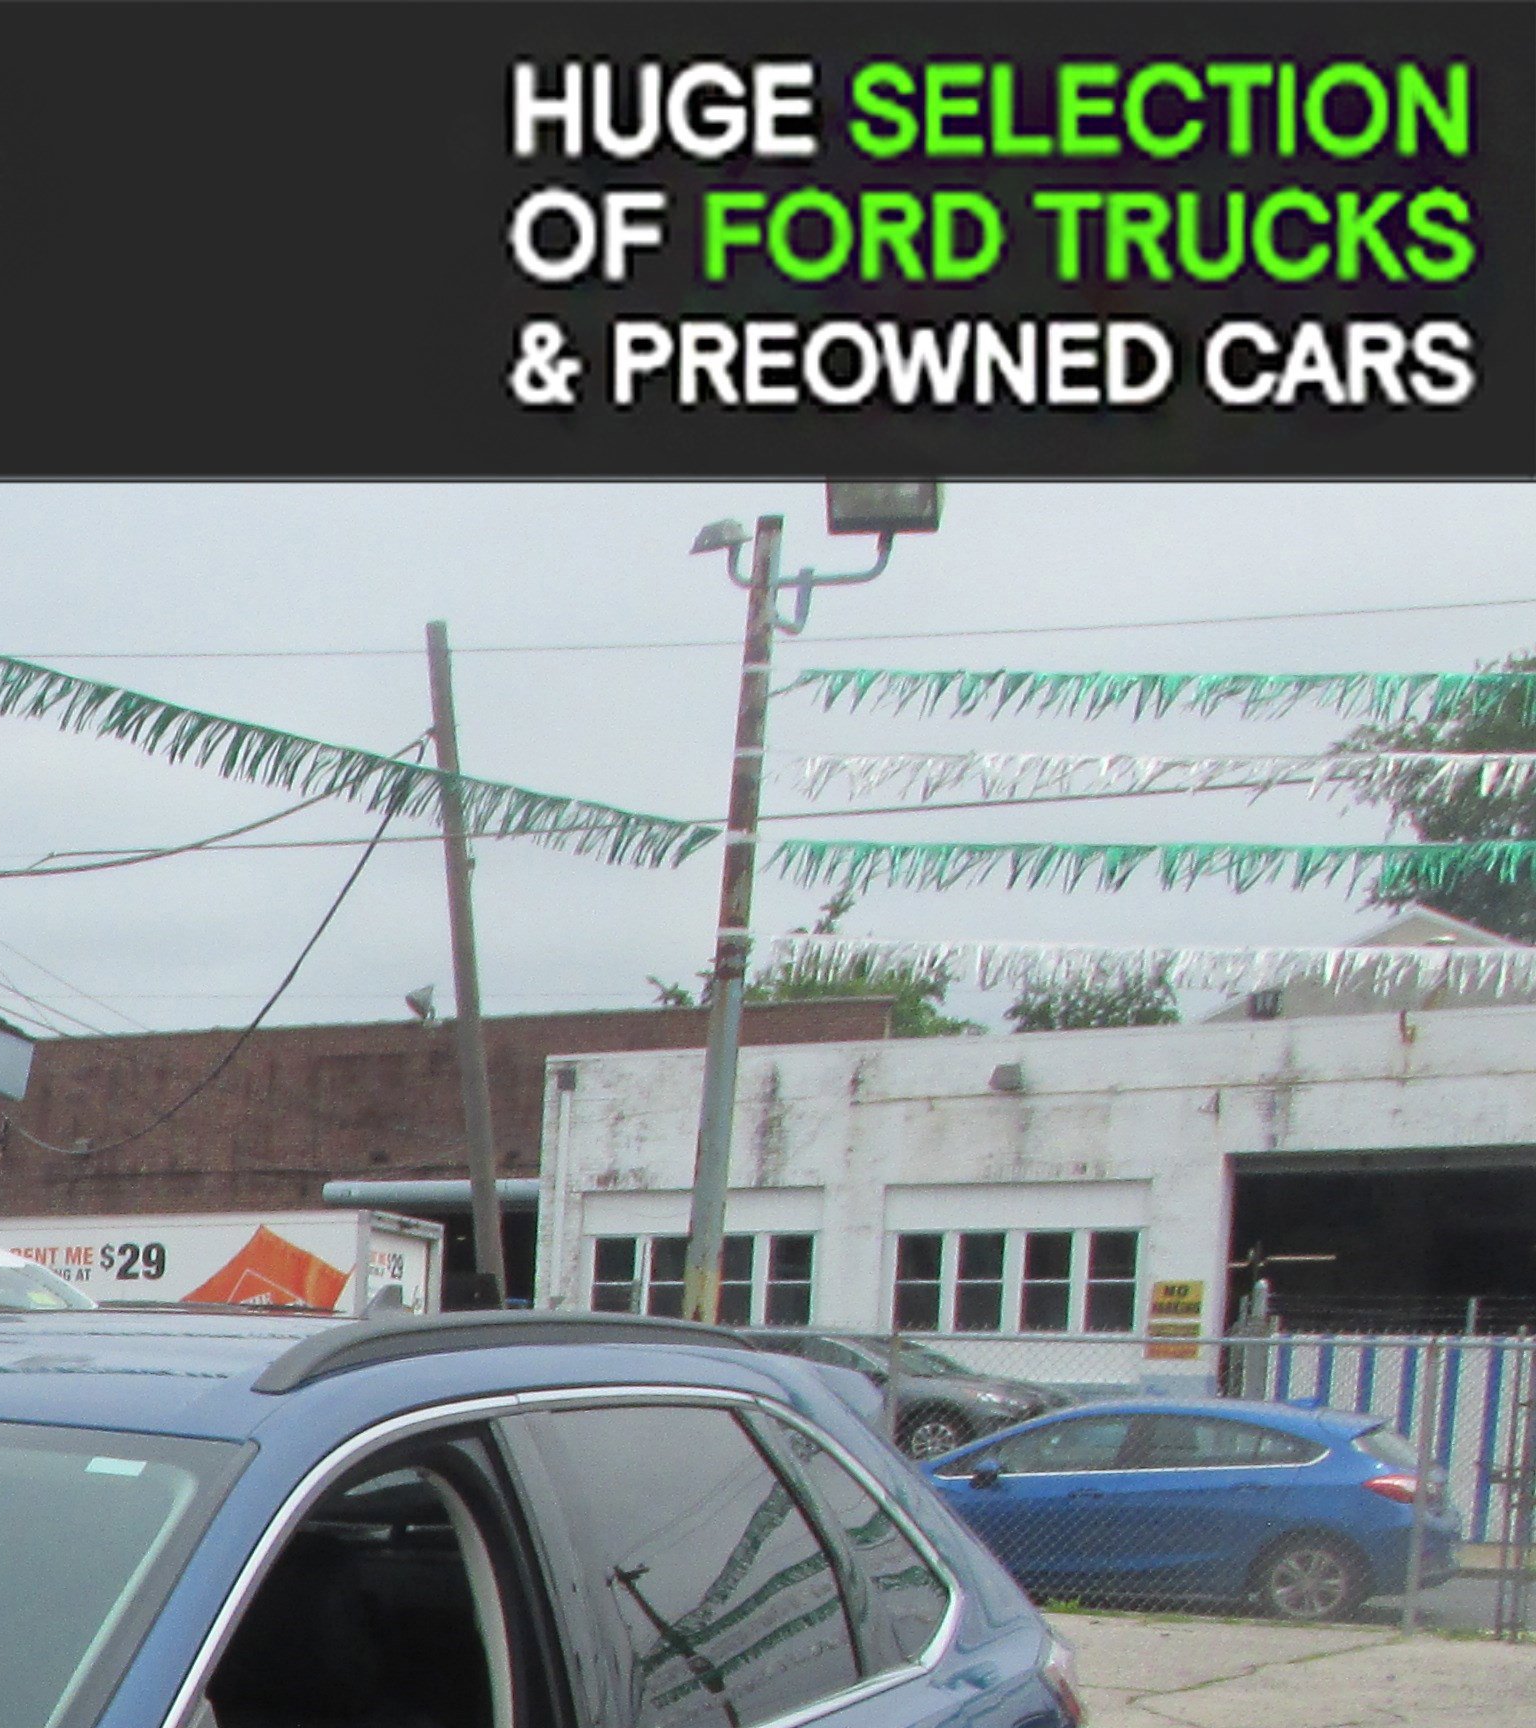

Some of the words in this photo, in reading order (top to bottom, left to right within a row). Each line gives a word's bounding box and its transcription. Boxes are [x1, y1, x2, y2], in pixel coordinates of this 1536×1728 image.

[65, 1246, 93, 1265] ME
[100, 1242, 167, 1281] $29
[75, 1268, 92, 1281] AT
